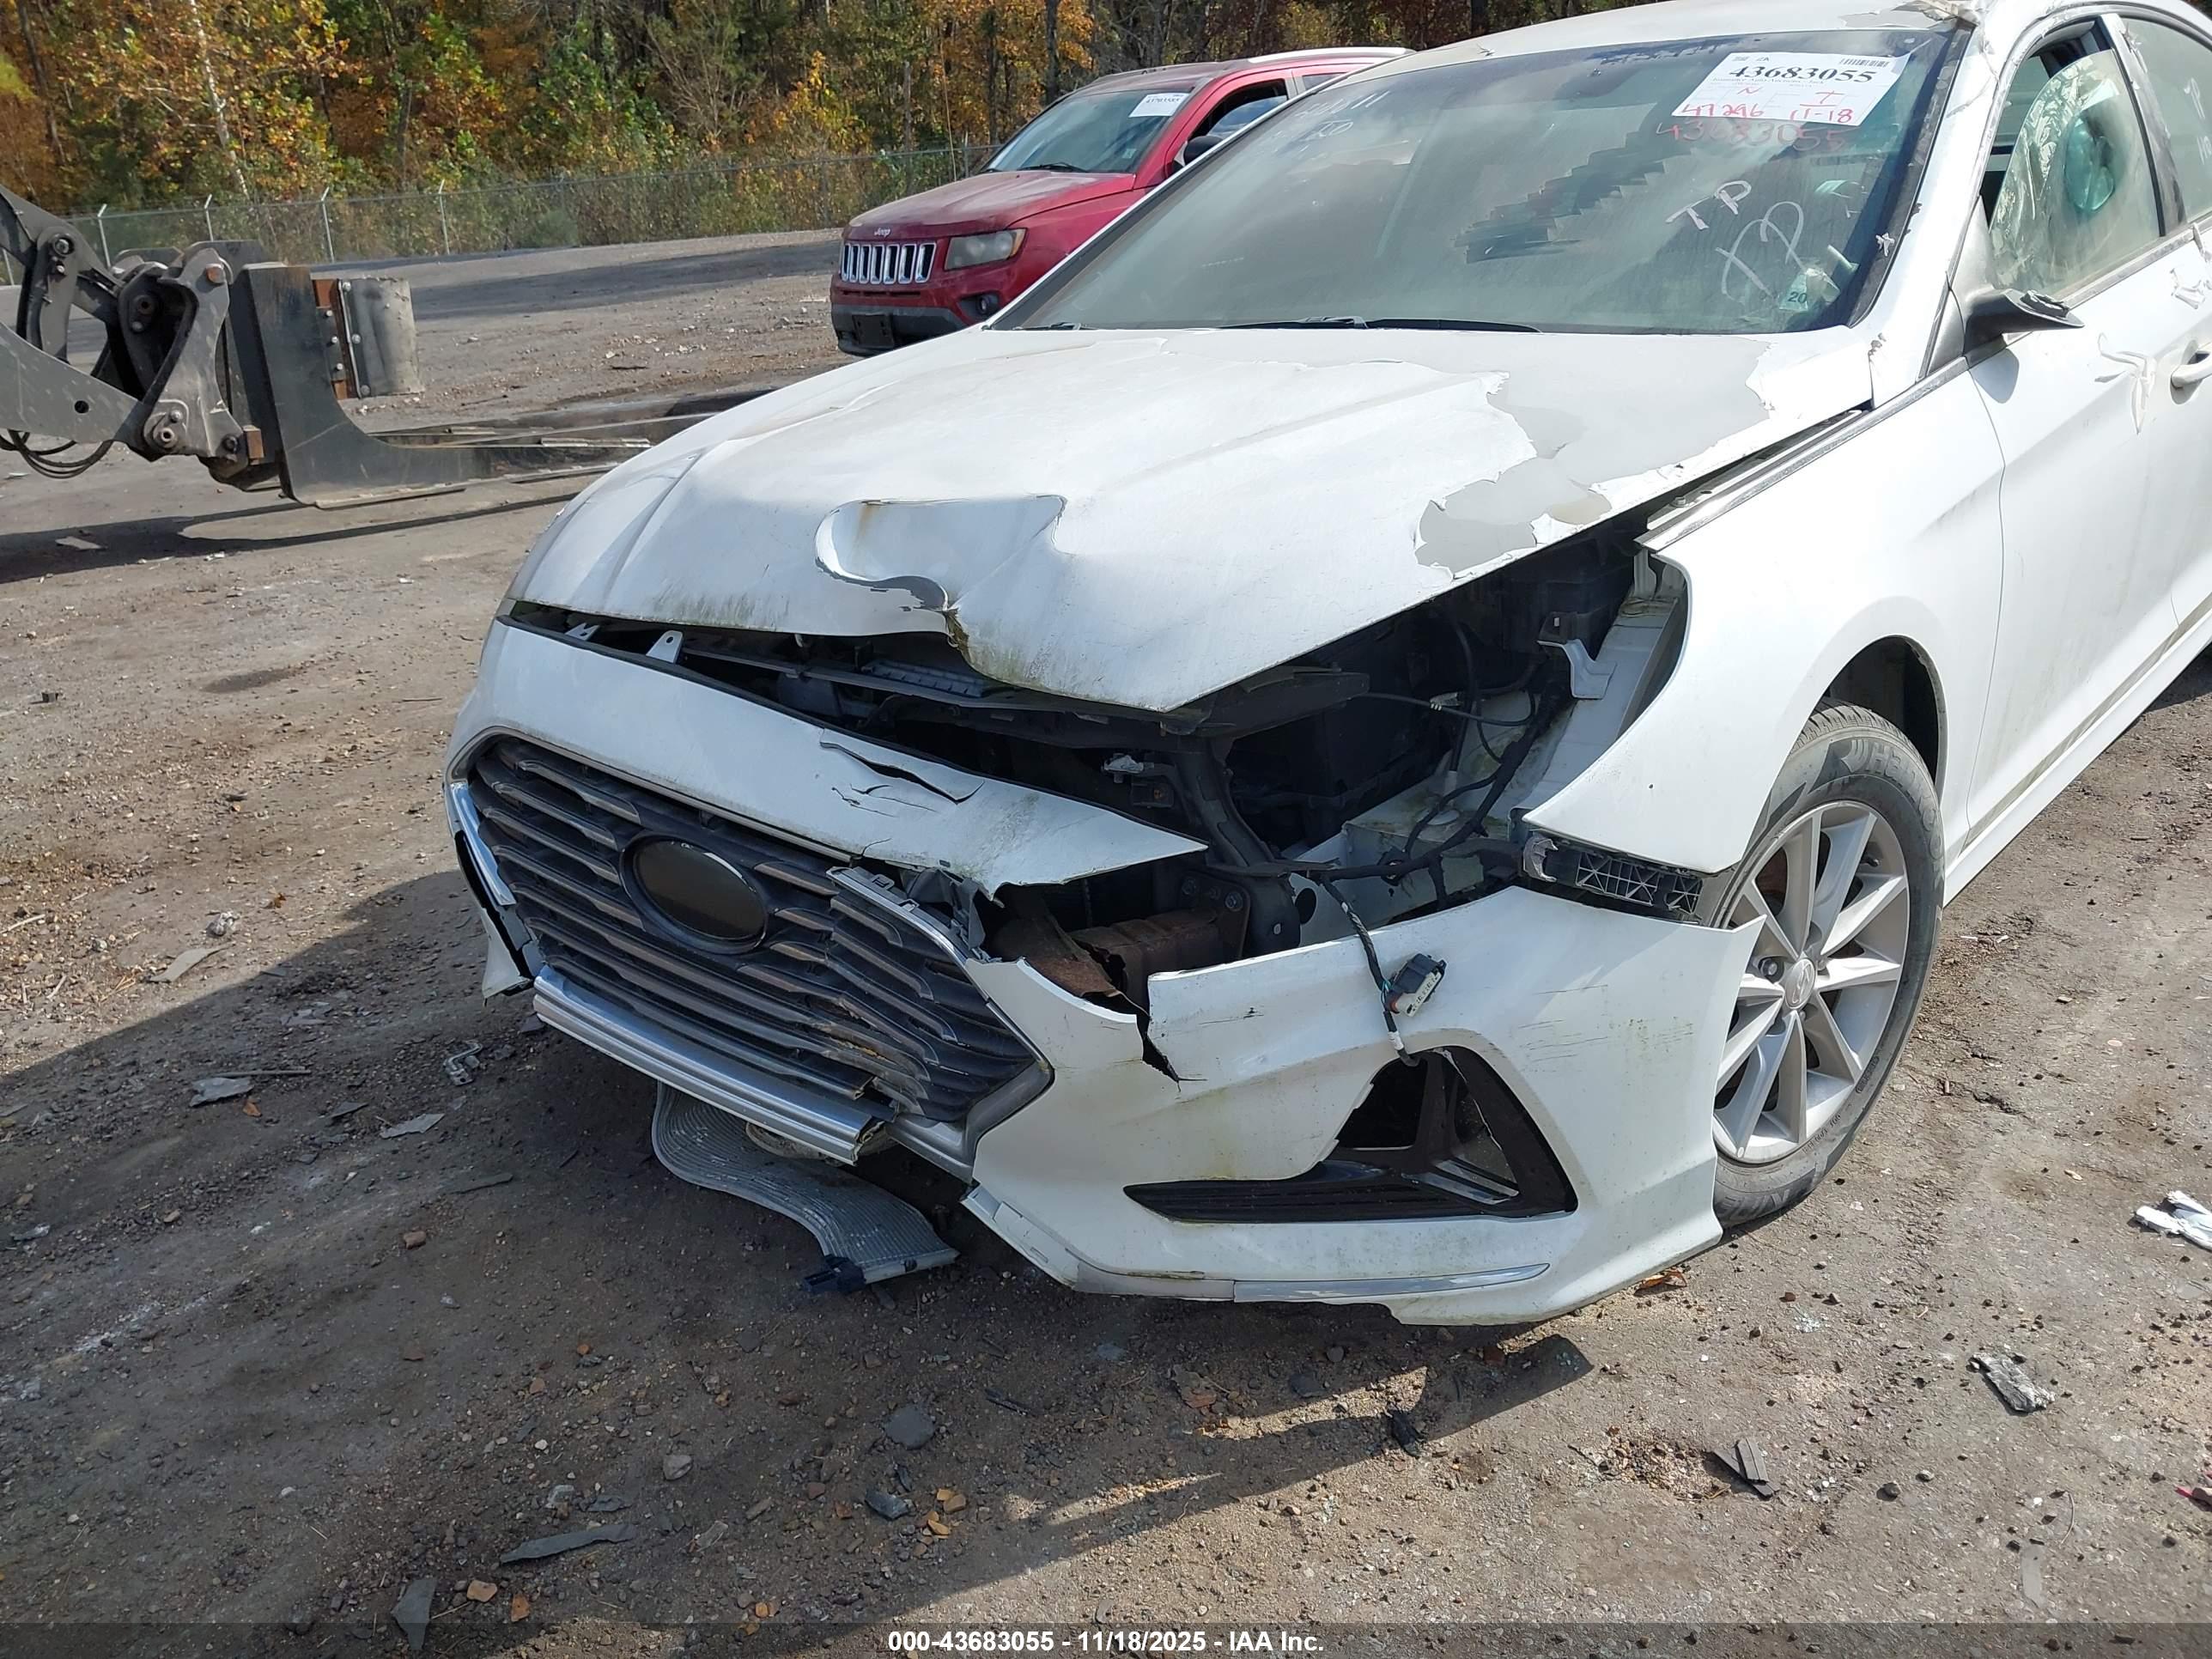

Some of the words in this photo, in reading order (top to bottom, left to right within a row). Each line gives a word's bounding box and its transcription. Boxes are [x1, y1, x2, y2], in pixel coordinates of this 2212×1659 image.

[1729, 65, 1878, 82] 43683055
[1790, 108, 1854, 124] 11-18
[874, 227, 891, 238] Jeep
[1786, 291, 1808, 303] 20
